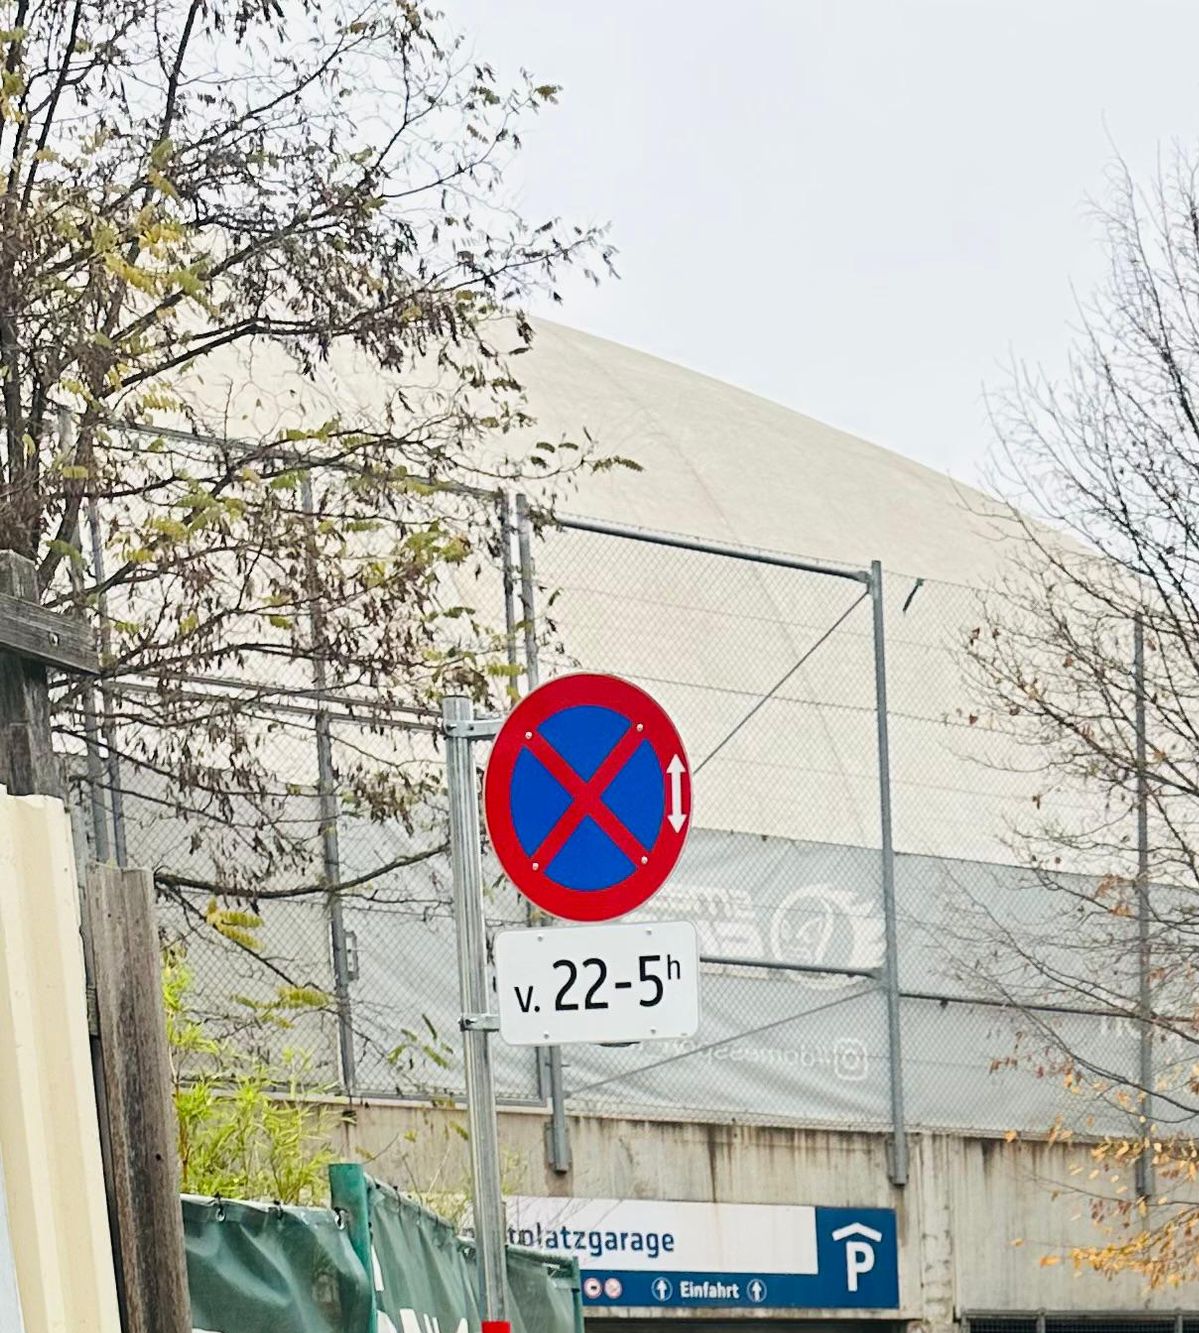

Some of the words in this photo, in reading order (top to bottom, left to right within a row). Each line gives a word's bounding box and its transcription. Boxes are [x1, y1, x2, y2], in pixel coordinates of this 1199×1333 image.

[514, 986, 541, 1013] v.
[507, 1221, 675, 1258] tplatzgarage
[846, 1240, 875, 1292] P
[680, 1281, 740, 1299] Einfahrt
